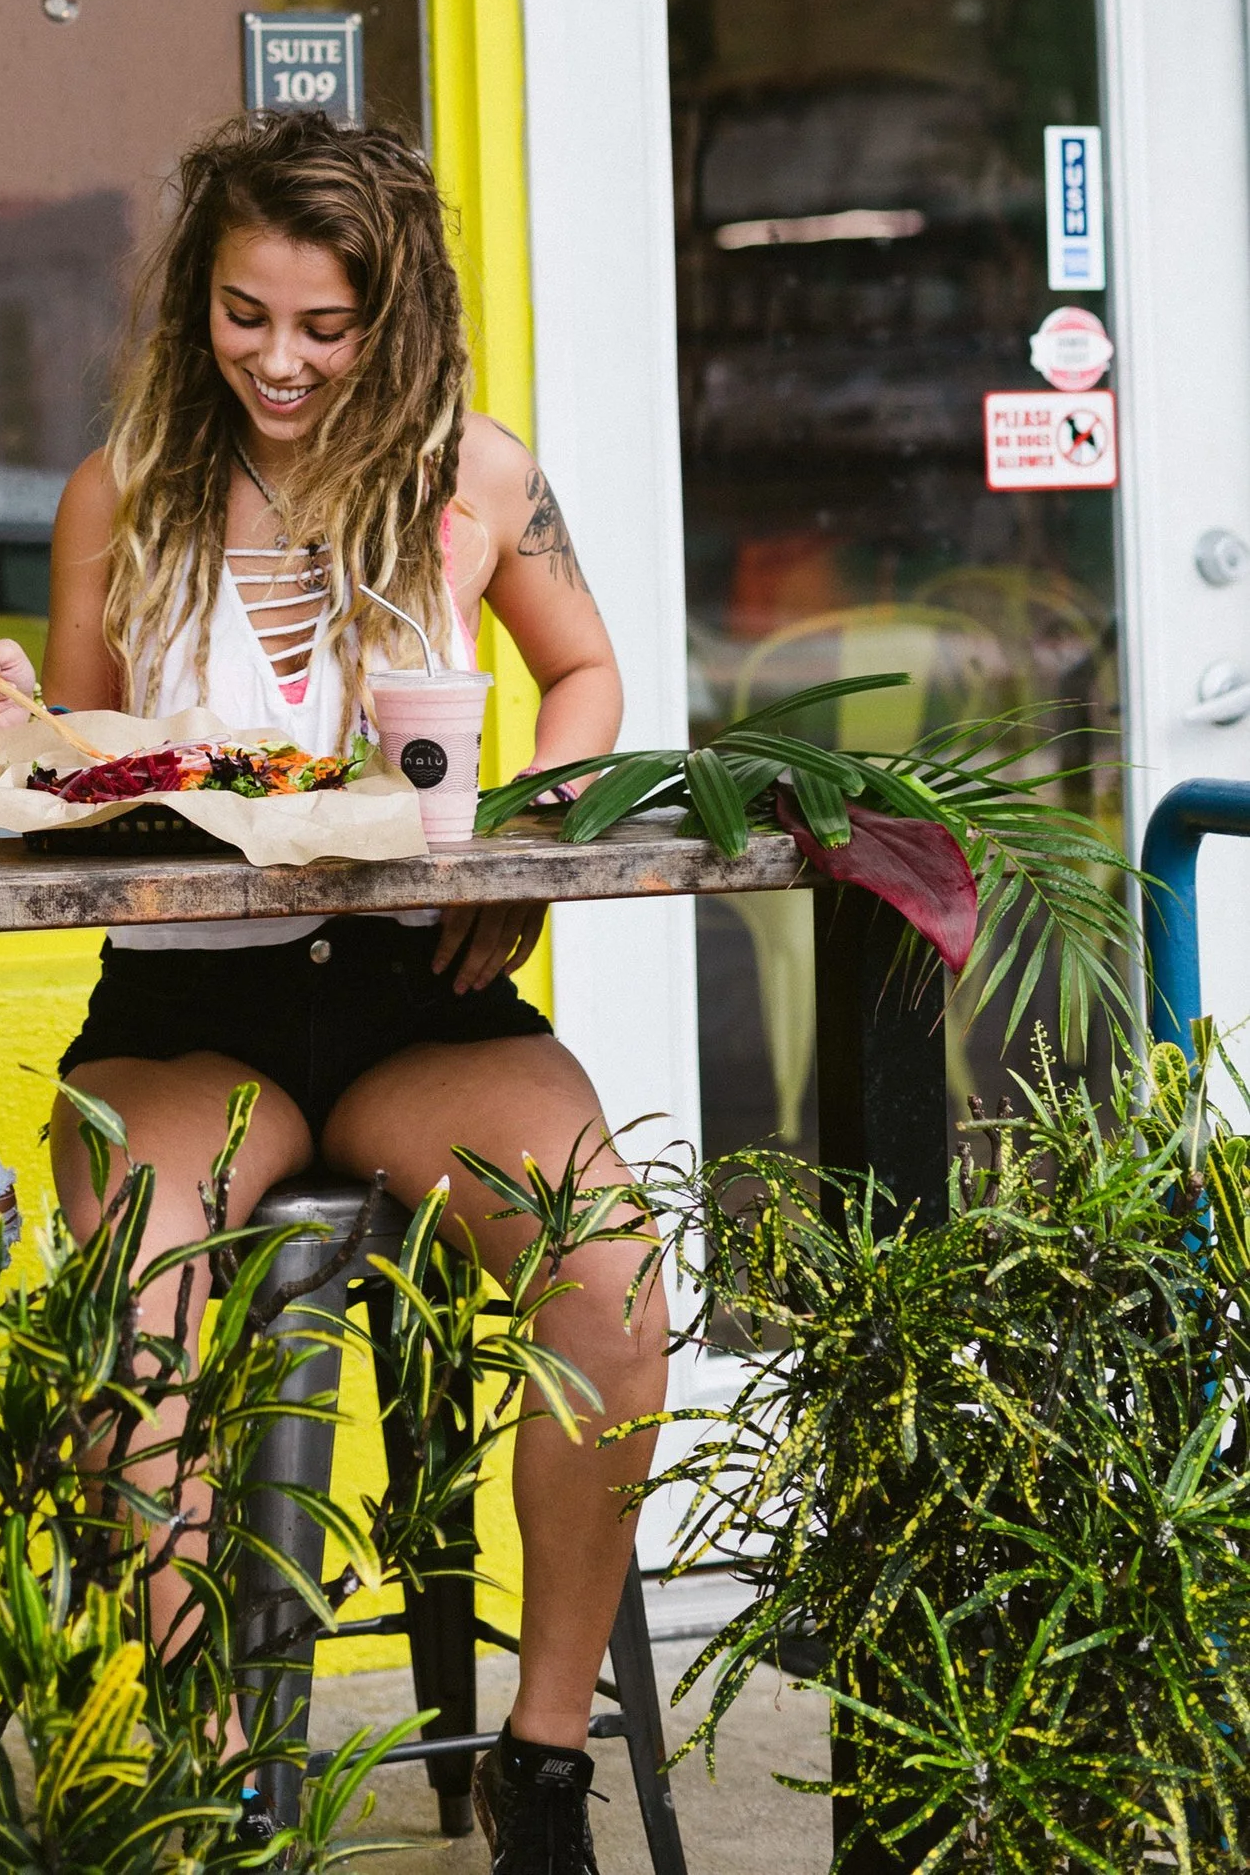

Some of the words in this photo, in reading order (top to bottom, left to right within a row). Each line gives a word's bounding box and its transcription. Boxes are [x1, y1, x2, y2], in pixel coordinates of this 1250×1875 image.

[266, 39, 342, 64] SUITE
[273, 71, 337, 103] 109
[1064, 141, 1085, 234] PUSH
[995, 411, 1051, 427] PLEASE
[541, 1758, 575, 1775] NIKE
